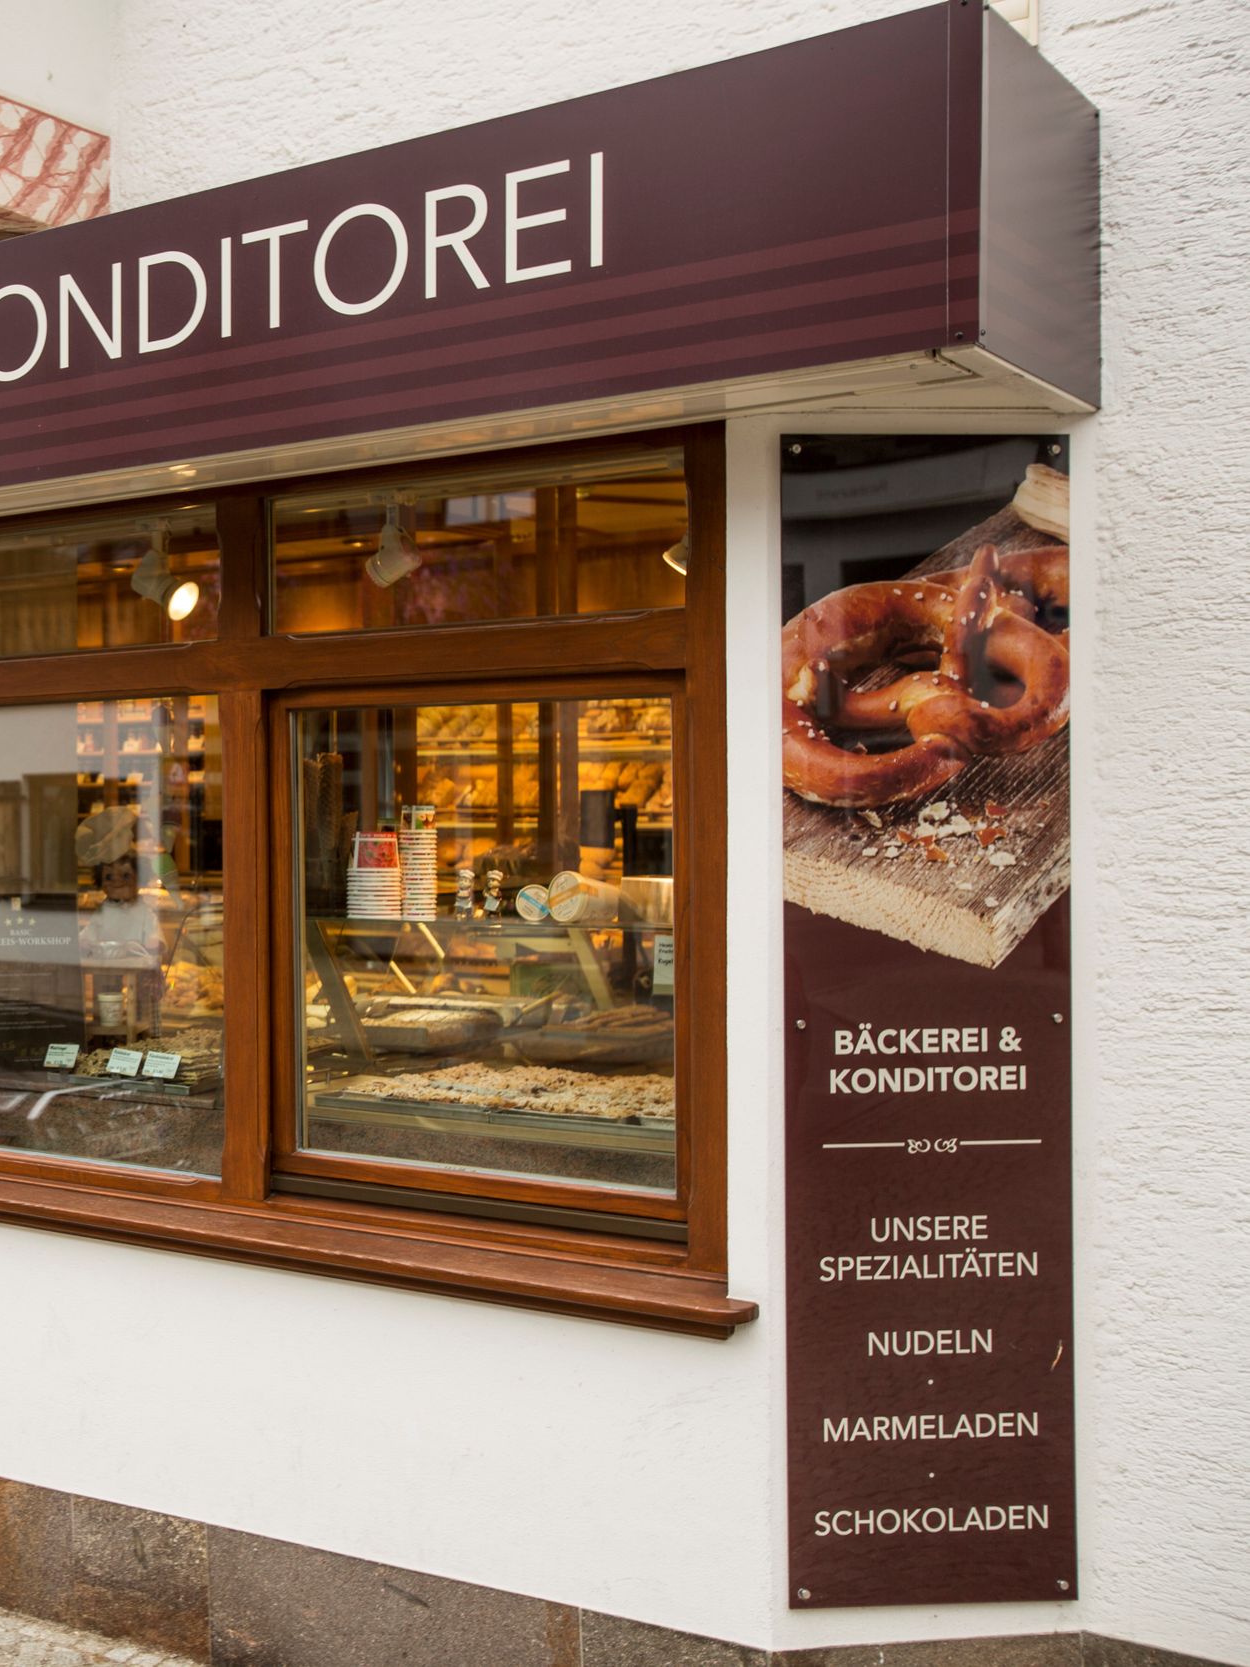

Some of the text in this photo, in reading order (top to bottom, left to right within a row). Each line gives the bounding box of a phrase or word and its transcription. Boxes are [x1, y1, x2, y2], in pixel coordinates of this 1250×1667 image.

[834, 1022, 1022, 1055] BÄCKEREI &
[829, 1065, 1027, 1094] KONDITOREI
[870, 1215, 989, 1243] UNSERE
[819, 1247, 1039, 1282] SPEZIALITÄTEN
[867, 1329, 993, 1357] NUDELN
[822, 1412, 1039, 1443] MARMELADEN
[814, 1505, 1049, 1537] SCHOKOLADEN
